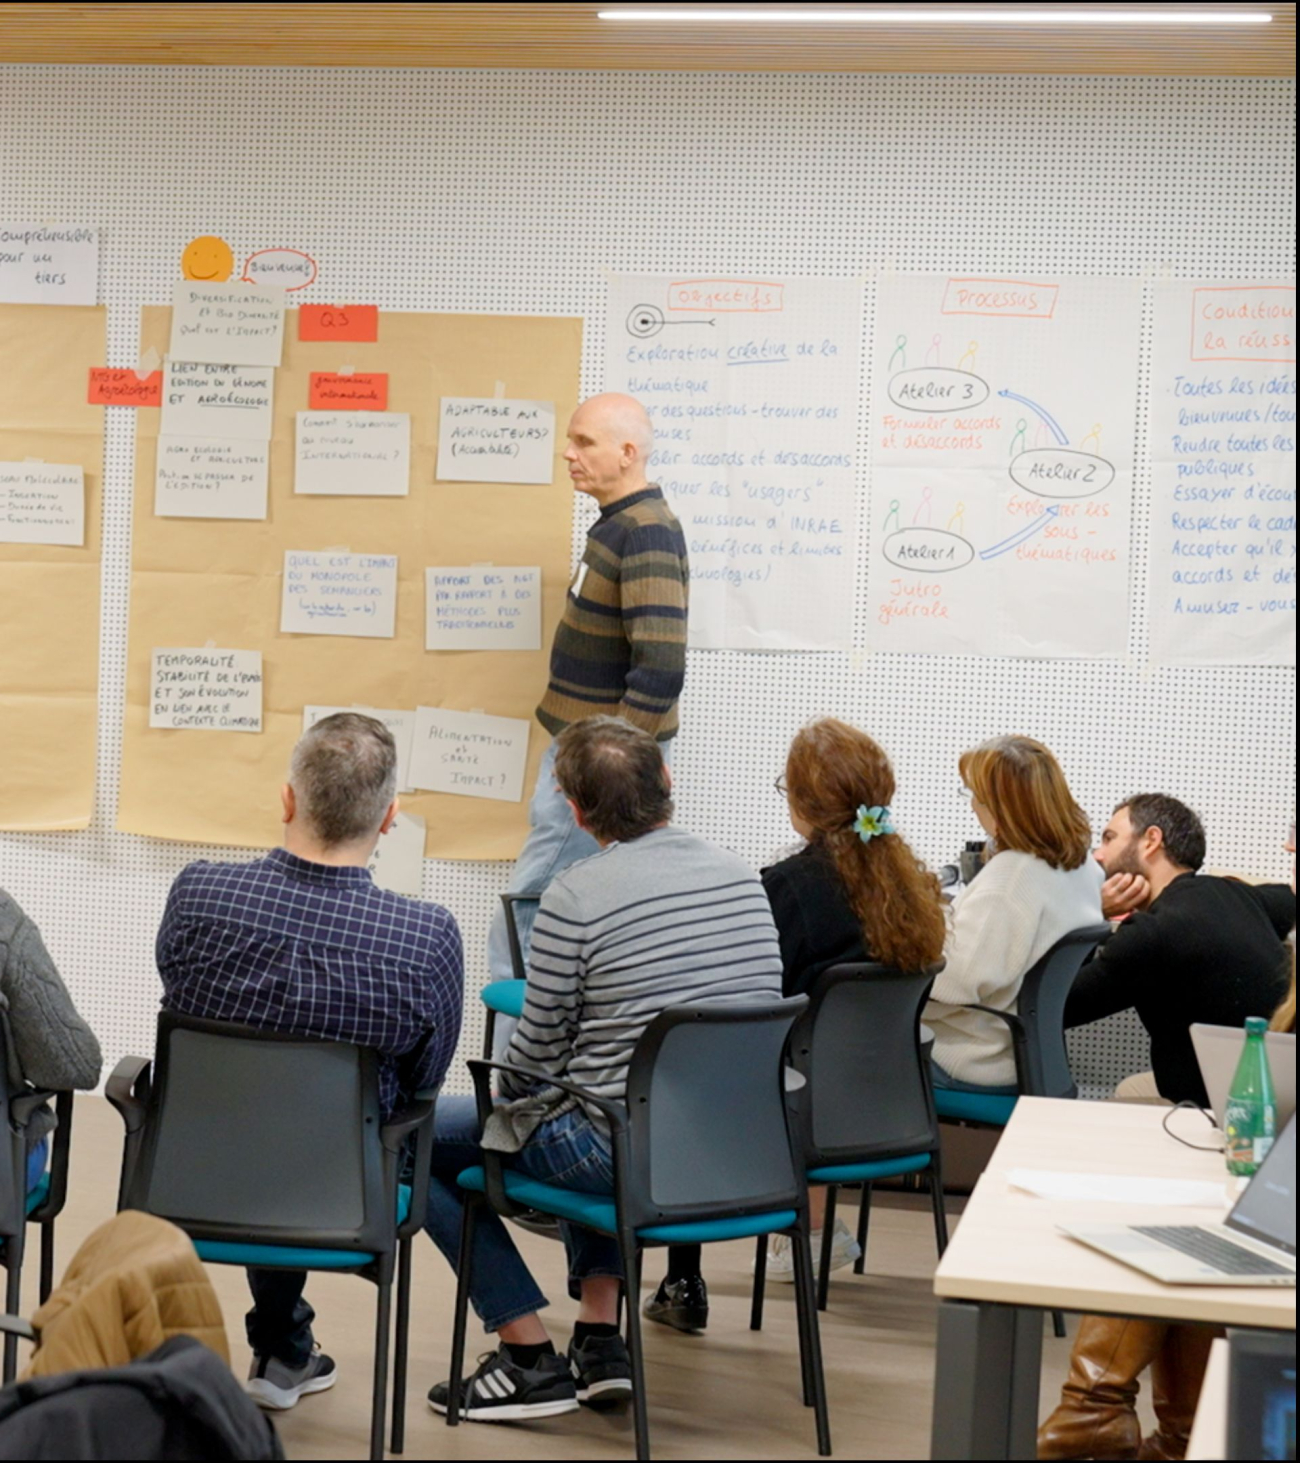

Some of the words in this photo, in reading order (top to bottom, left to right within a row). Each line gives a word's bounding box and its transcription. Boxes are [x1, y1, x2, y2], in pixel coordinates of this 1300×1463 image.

[33, 253, 52, 263] un
[35, 272, 66, 285] tiers
[678, 287, 772, 312] Objectifs
[957, 289, 1038, 310] Processus
[1204, 331, 1227, 350] la
[626, 343, 719, 365] Exploration
[727, 338, 788, 358] créative
[796, 341, 813, 356] de
[820, 339, 839, 356] la
[627, 376, 708, 393] thématique
[899, 382, 955, 400] Atelier
[962, 383, 974, 400] 3
[1174, 376, 1223, 397] Toutes
[1228, 376, 1254, 394] les
[169, 394, 185, 404] ET
[661, 404, 683, 417] des
[688, 404, 747, 423] questions
[815, 407, 839, 419] des
[883, 415, 948, 430] Formuler
[954, 416, 1002, 430] accords
[882, 435, 897, 449] et
[1172, 434, 1221, 453] Rendre
[1227, 432, 1268, 452] toutes
[1273, 434, 1294, 452] les
[692, 450, 744, 466] accords
[750, 451, 765, 466] et
[1029, 463, 1079, 481] Atelier
[1082, 464, 1097, 482] 2
[1177, 458, 1255, 480] publiques
[708, 481, 731, 496] les
[1173, 484, 1235, 502] Essayer
[1085, 501, 1110, 517] les
[693, 514, 756, 527] mission
[1172, 512, 1243, 534] Respecter
[1248, 514, 1261, 531] le
[771, 541, 784, 555] et
[897, 545, 948, 560] Atelier
[1016, 544, 1117, 563] thématiques
[1172, 539, 1238, 559] Accepter
[1245, 537, 1284, 560] qu'il
[1172, 567, 1234, 584] accords
[1244, 564, 1260, 582] et
[890, 579, 942, 597] Intro
[216, 672, 228, 683] DE
[154, 687, 173, 698] ET
[179, 688, 196, 699] SON
[154, 704, 168, 715] EN
